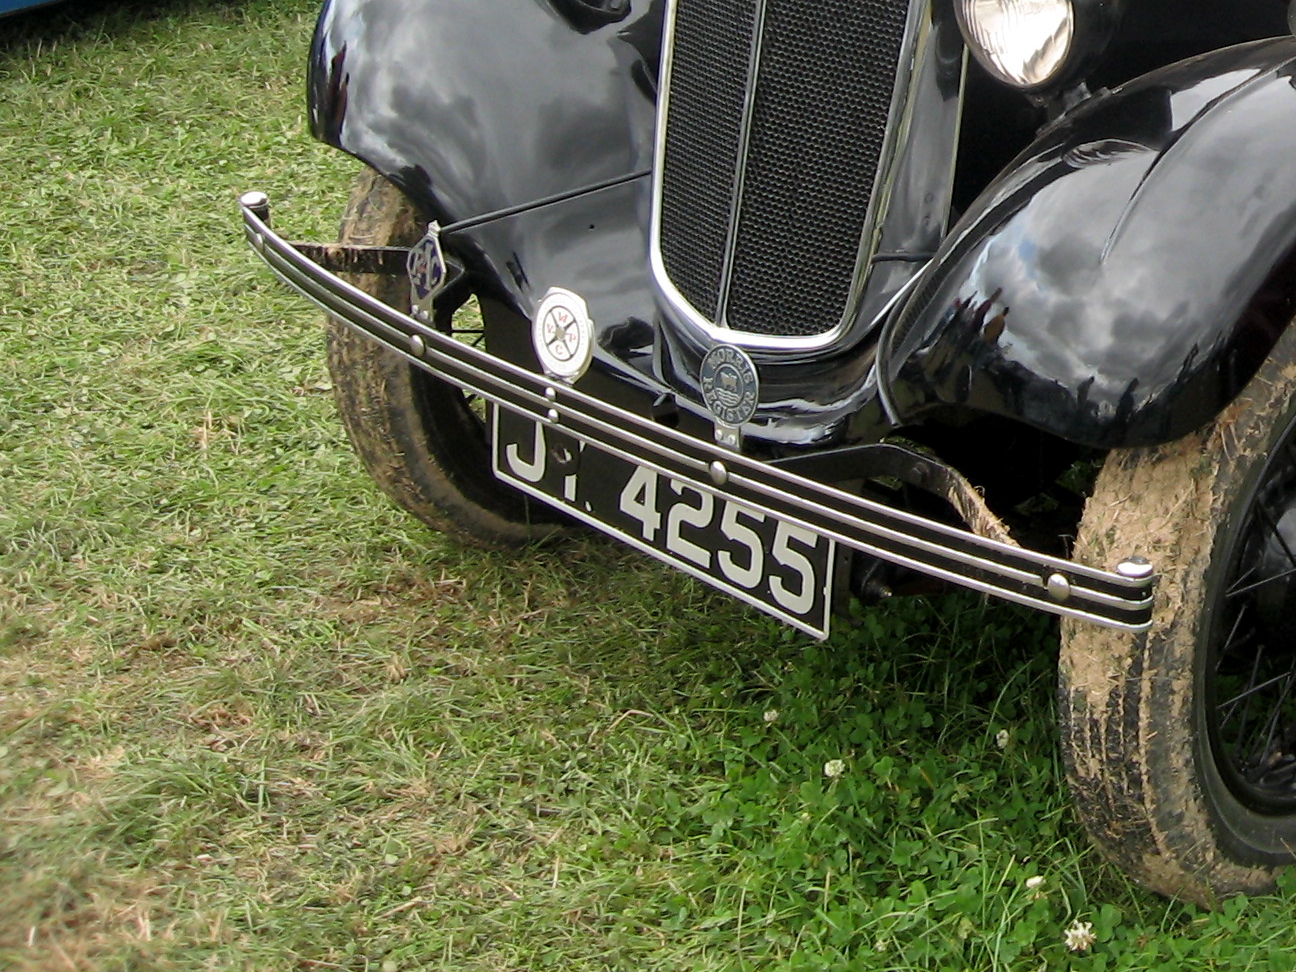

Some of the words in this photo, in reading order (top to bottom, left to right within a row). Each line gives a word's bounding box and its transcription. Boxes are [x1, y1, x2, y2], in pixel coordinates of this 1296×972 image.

[707, 348, 754, 384] MORRIS
[703, 376, 756, 422] REGISTER
[620, 465, 818, 615] 4255
